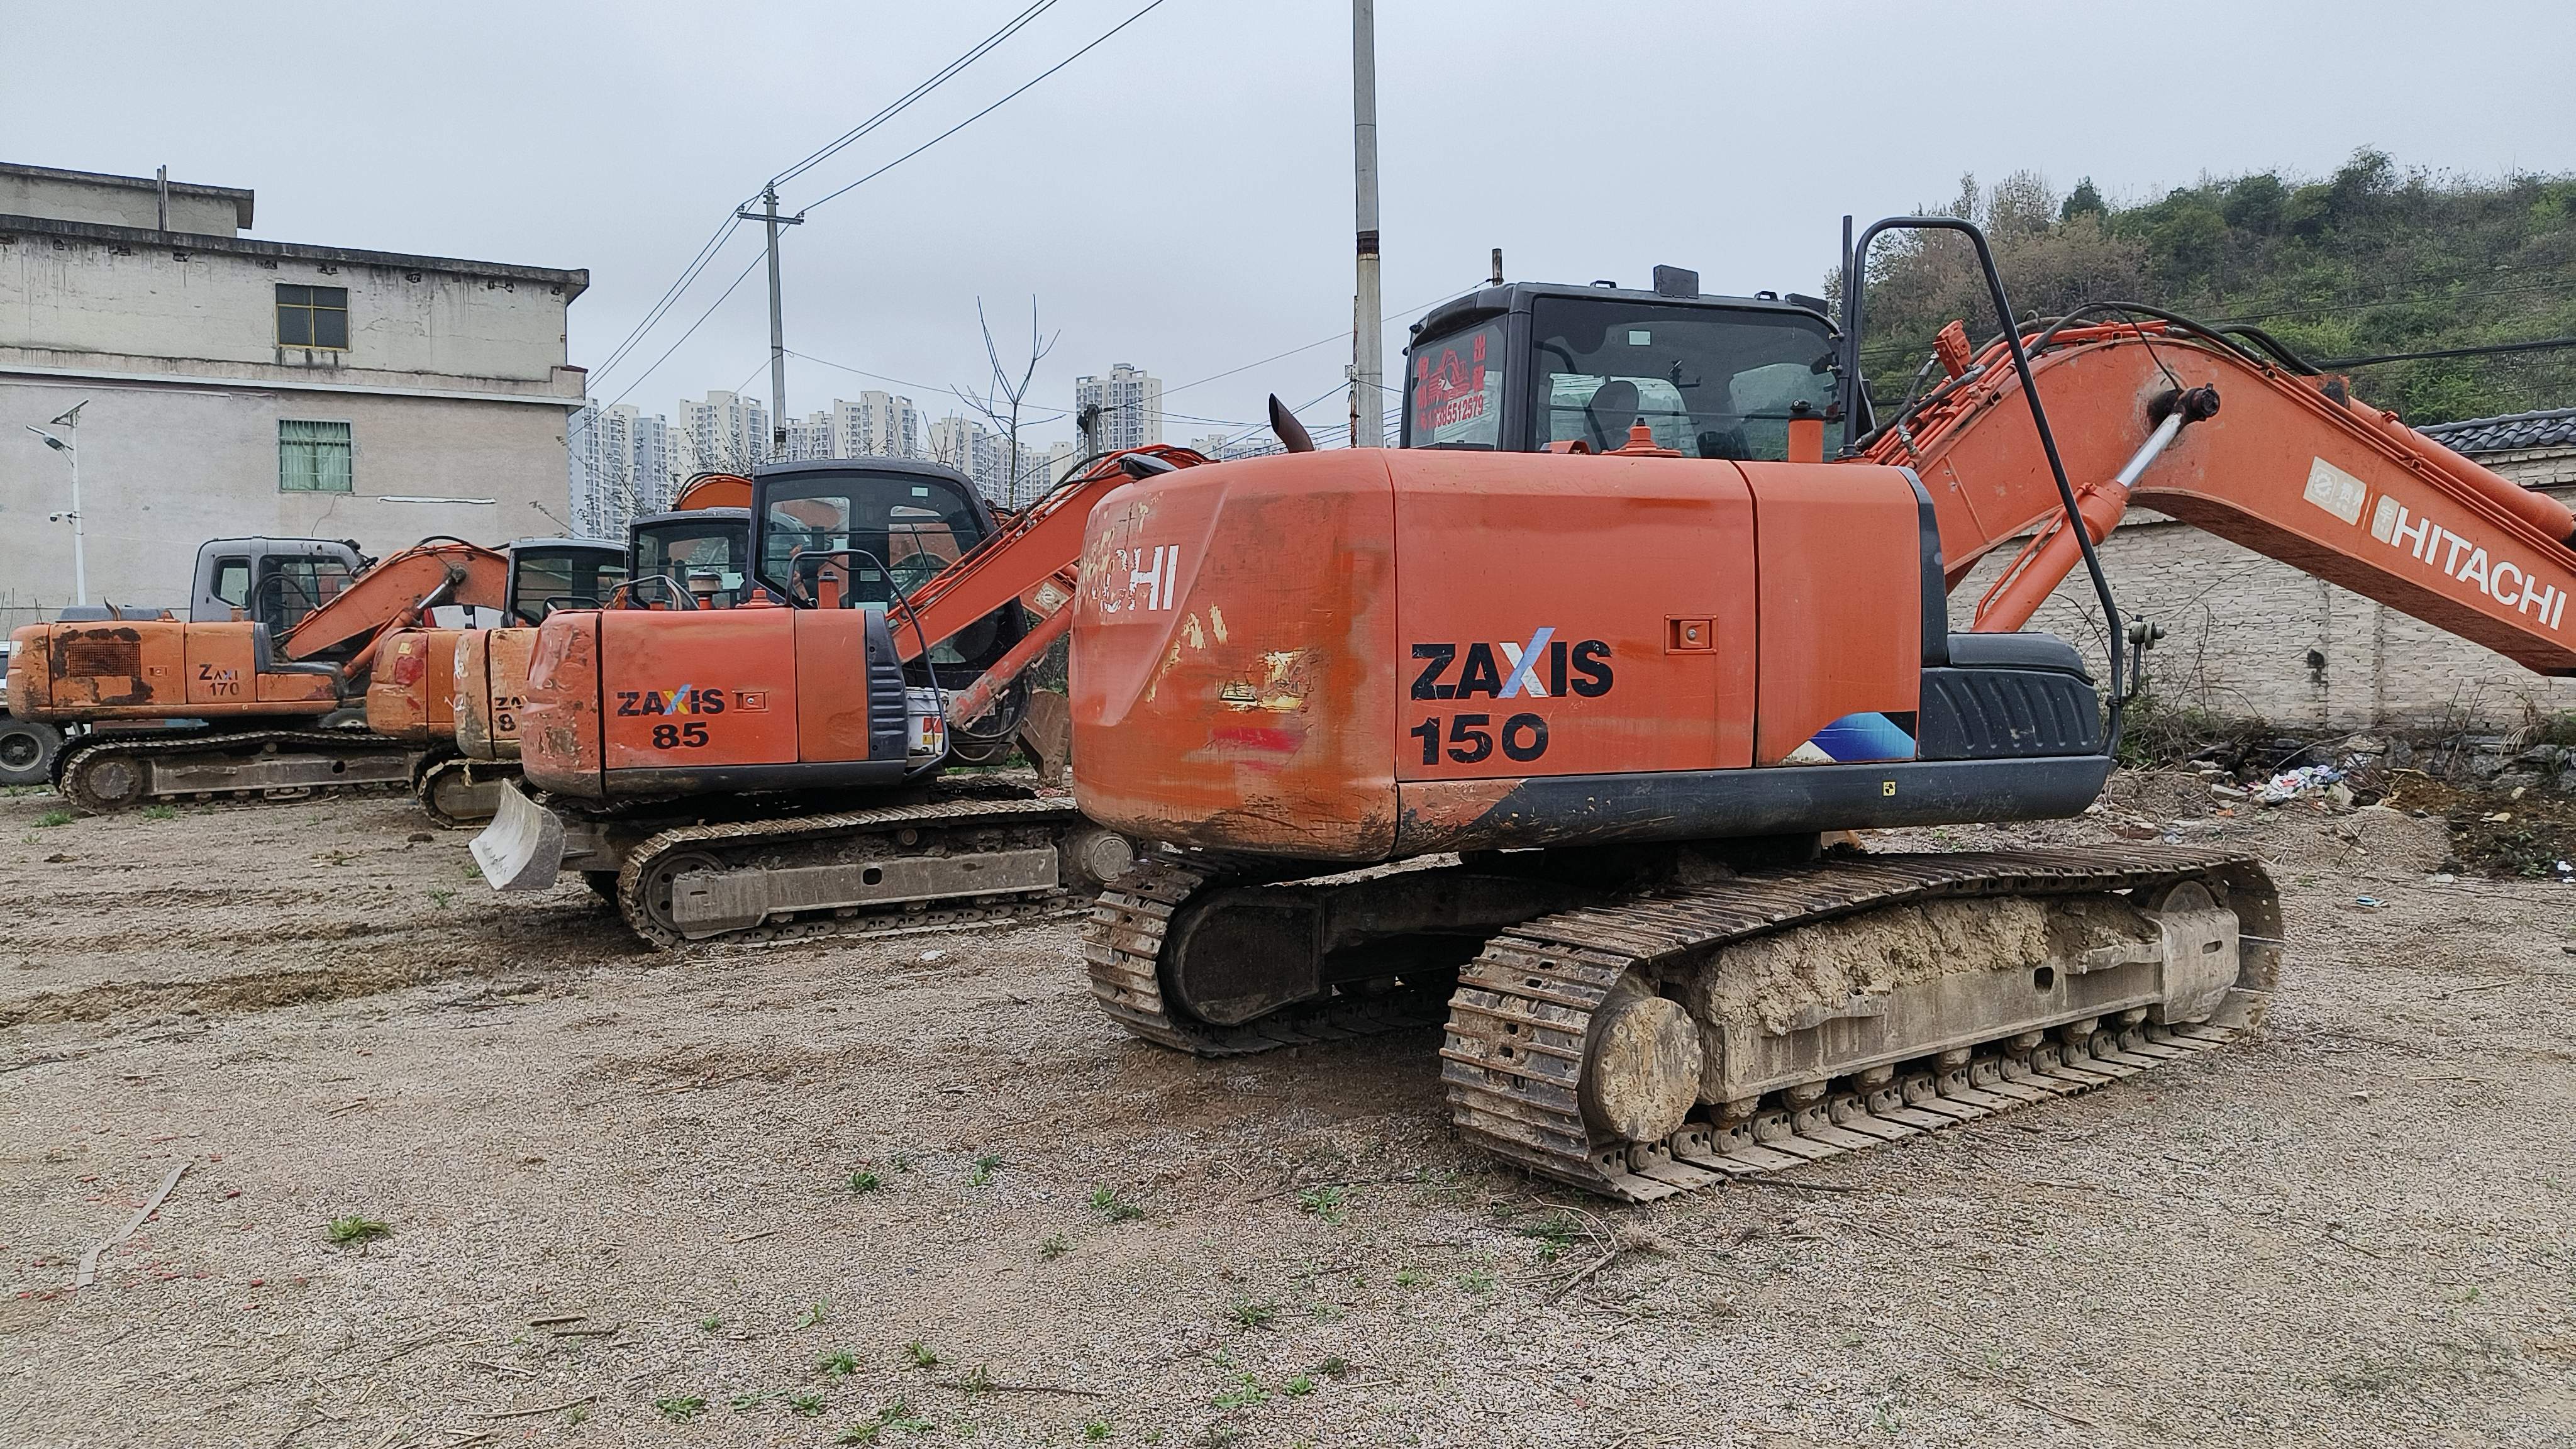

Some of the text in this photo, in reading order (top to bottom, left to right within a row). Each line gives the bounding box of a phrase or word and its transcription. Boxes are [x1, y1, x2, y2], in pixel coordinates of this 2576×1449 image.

[2391, 506, 2567, 631] HITACHI
[1411, 626, 1614, 701] ZAXIS
[209, 682, 240, 696] 170
[618, 684, 725, 717] ZAXIS
[652, 721, 709, 750] 85
[1411, 713, 1549, 765] 150
